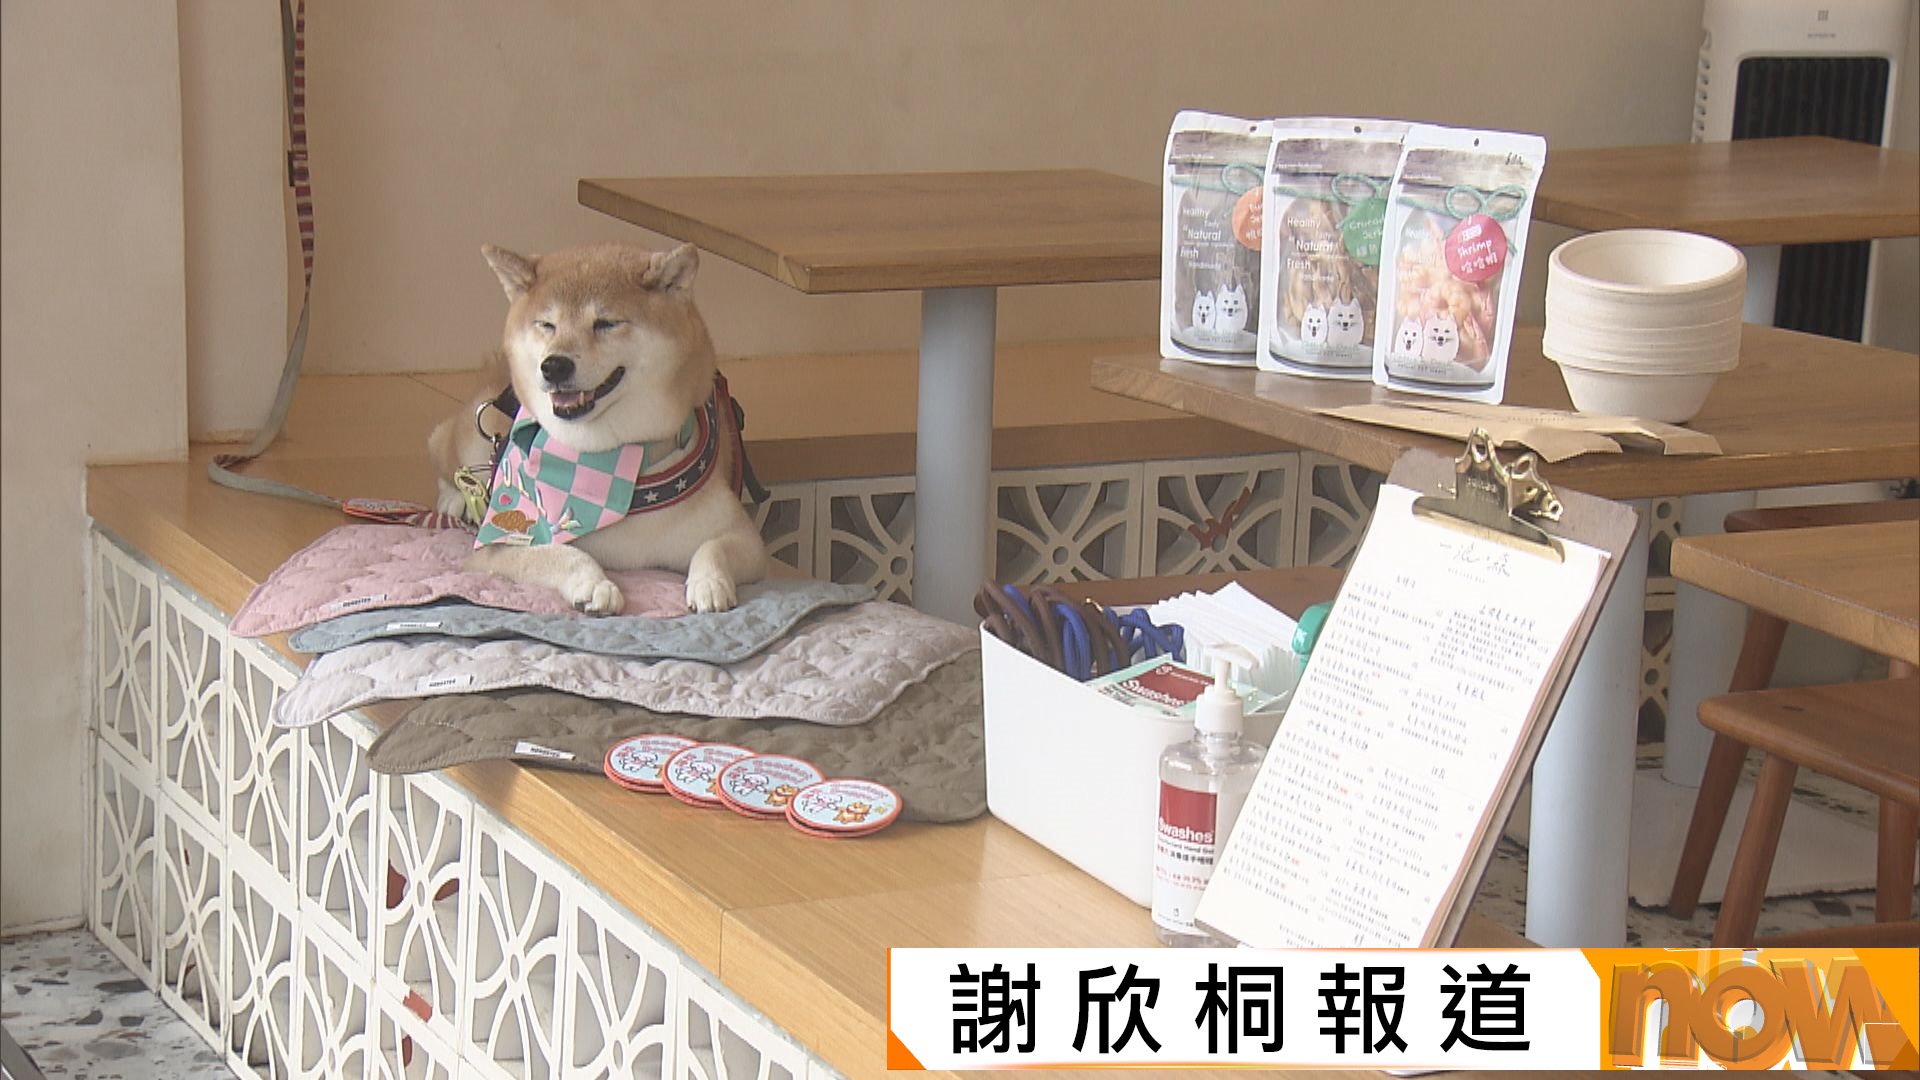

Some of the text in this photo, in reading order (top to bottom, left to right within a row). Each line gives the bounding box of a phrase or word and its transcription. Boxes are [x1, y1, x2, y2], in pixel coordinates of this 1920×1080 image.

[1286, 215, 1321, 229] Healthy
[1187, 227, 1222, 241] Natural
[1296, 239, 1334, 253] Natural
[1457, 239, 1493, 259] Shrimp
[1286, 258, 1311, 270] Fresh
